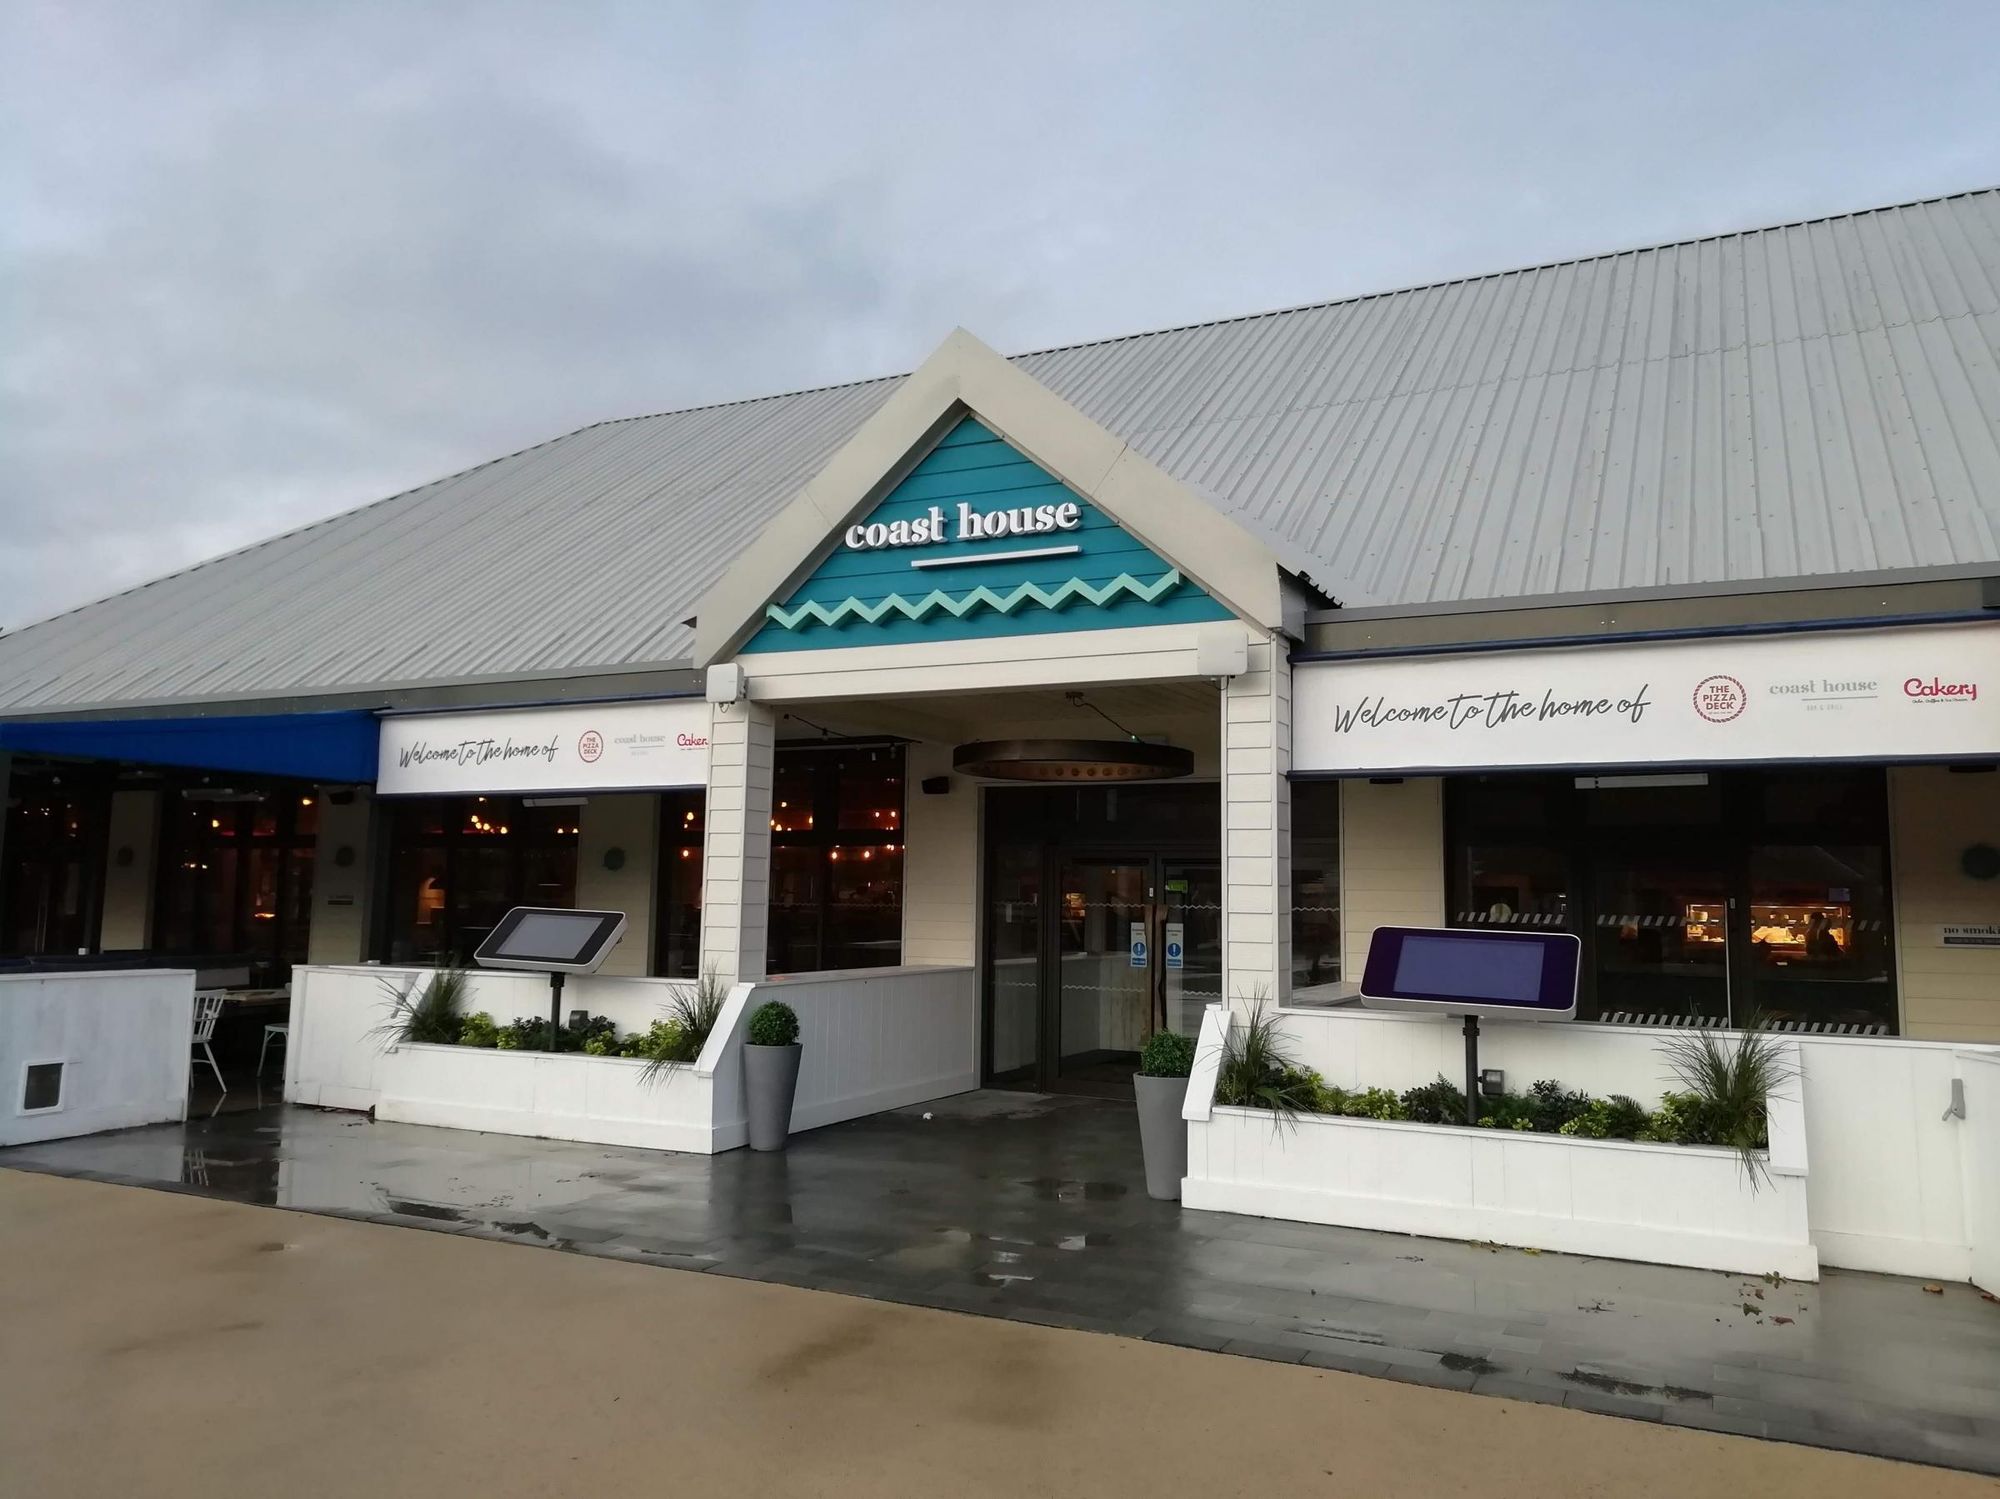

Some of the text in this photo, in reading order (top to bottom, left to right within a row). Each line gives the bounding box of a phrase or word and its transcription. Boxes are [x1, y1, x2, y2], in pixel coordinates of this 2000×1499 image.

[844, 501, 1081, 549] coast house
[1709, 685, 1730, 693] THE
[1768, 679, 1877, 695] coast house
[1904, 676, 1977, 701] Cakery
[1702, 693, 1737, 702] PIZZA
[1705, 701, 1734, 710] DECK
[1334, 684, 1652, 733] Welcome to the home of
[677, 733, 709, 747] Caker
[399, 735, 559, 767] Welcome to the home of
